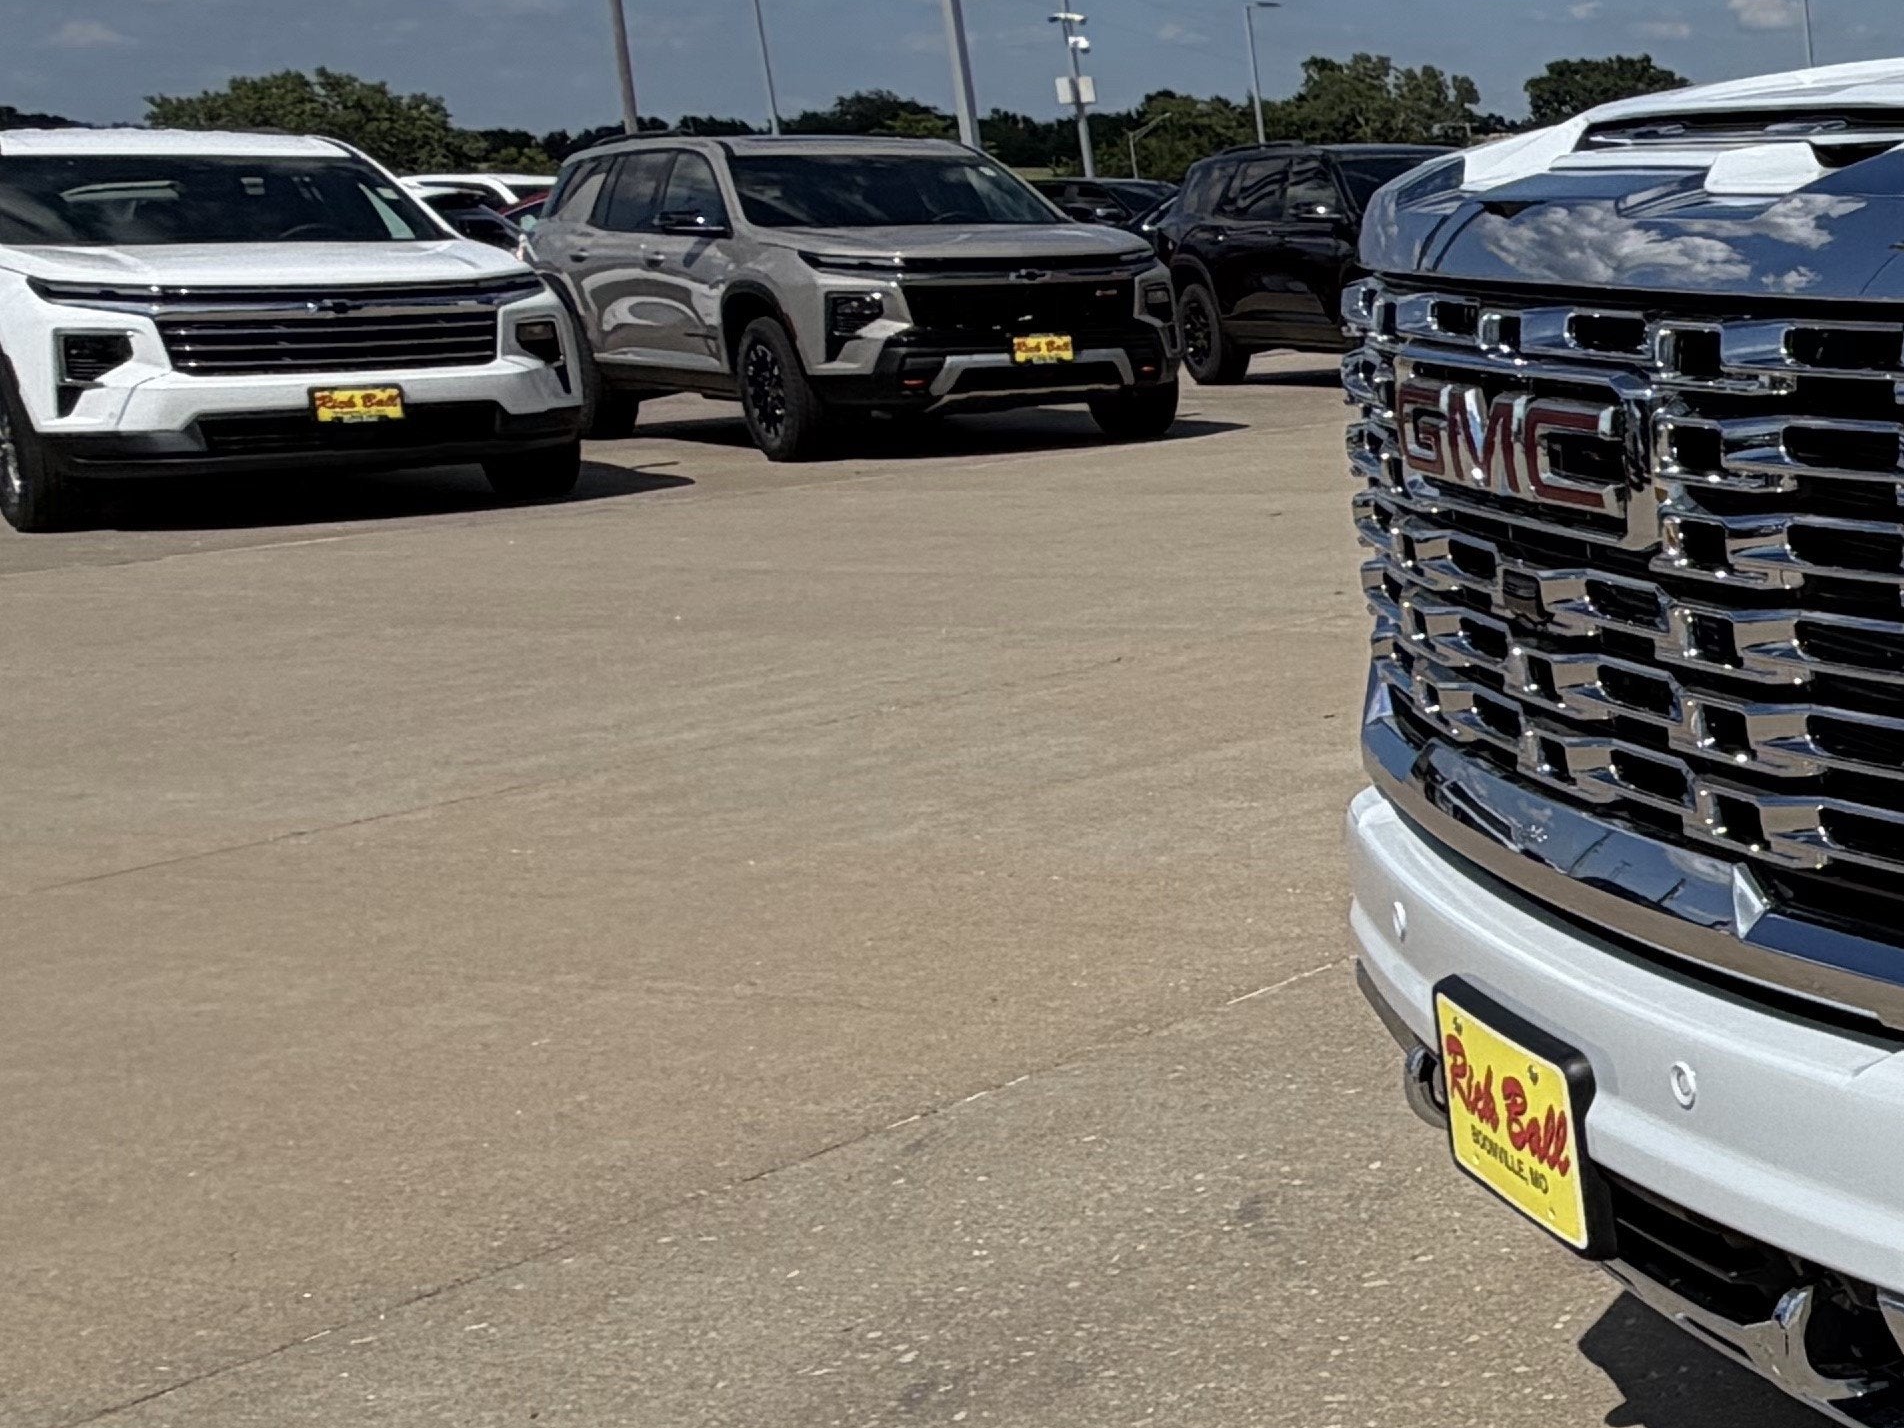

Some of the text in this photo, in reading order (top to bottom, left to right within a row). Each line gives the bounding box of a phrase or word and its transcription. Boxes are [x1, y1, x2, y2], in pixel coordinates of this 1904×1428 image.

[315, 393, 400, 409] Rick Ball
[1398, 378, 1626, 515] GMC
[1445, 1034, 1570, 1177] Rick Ball
[1529, 1166, 1549, 1194] MO
